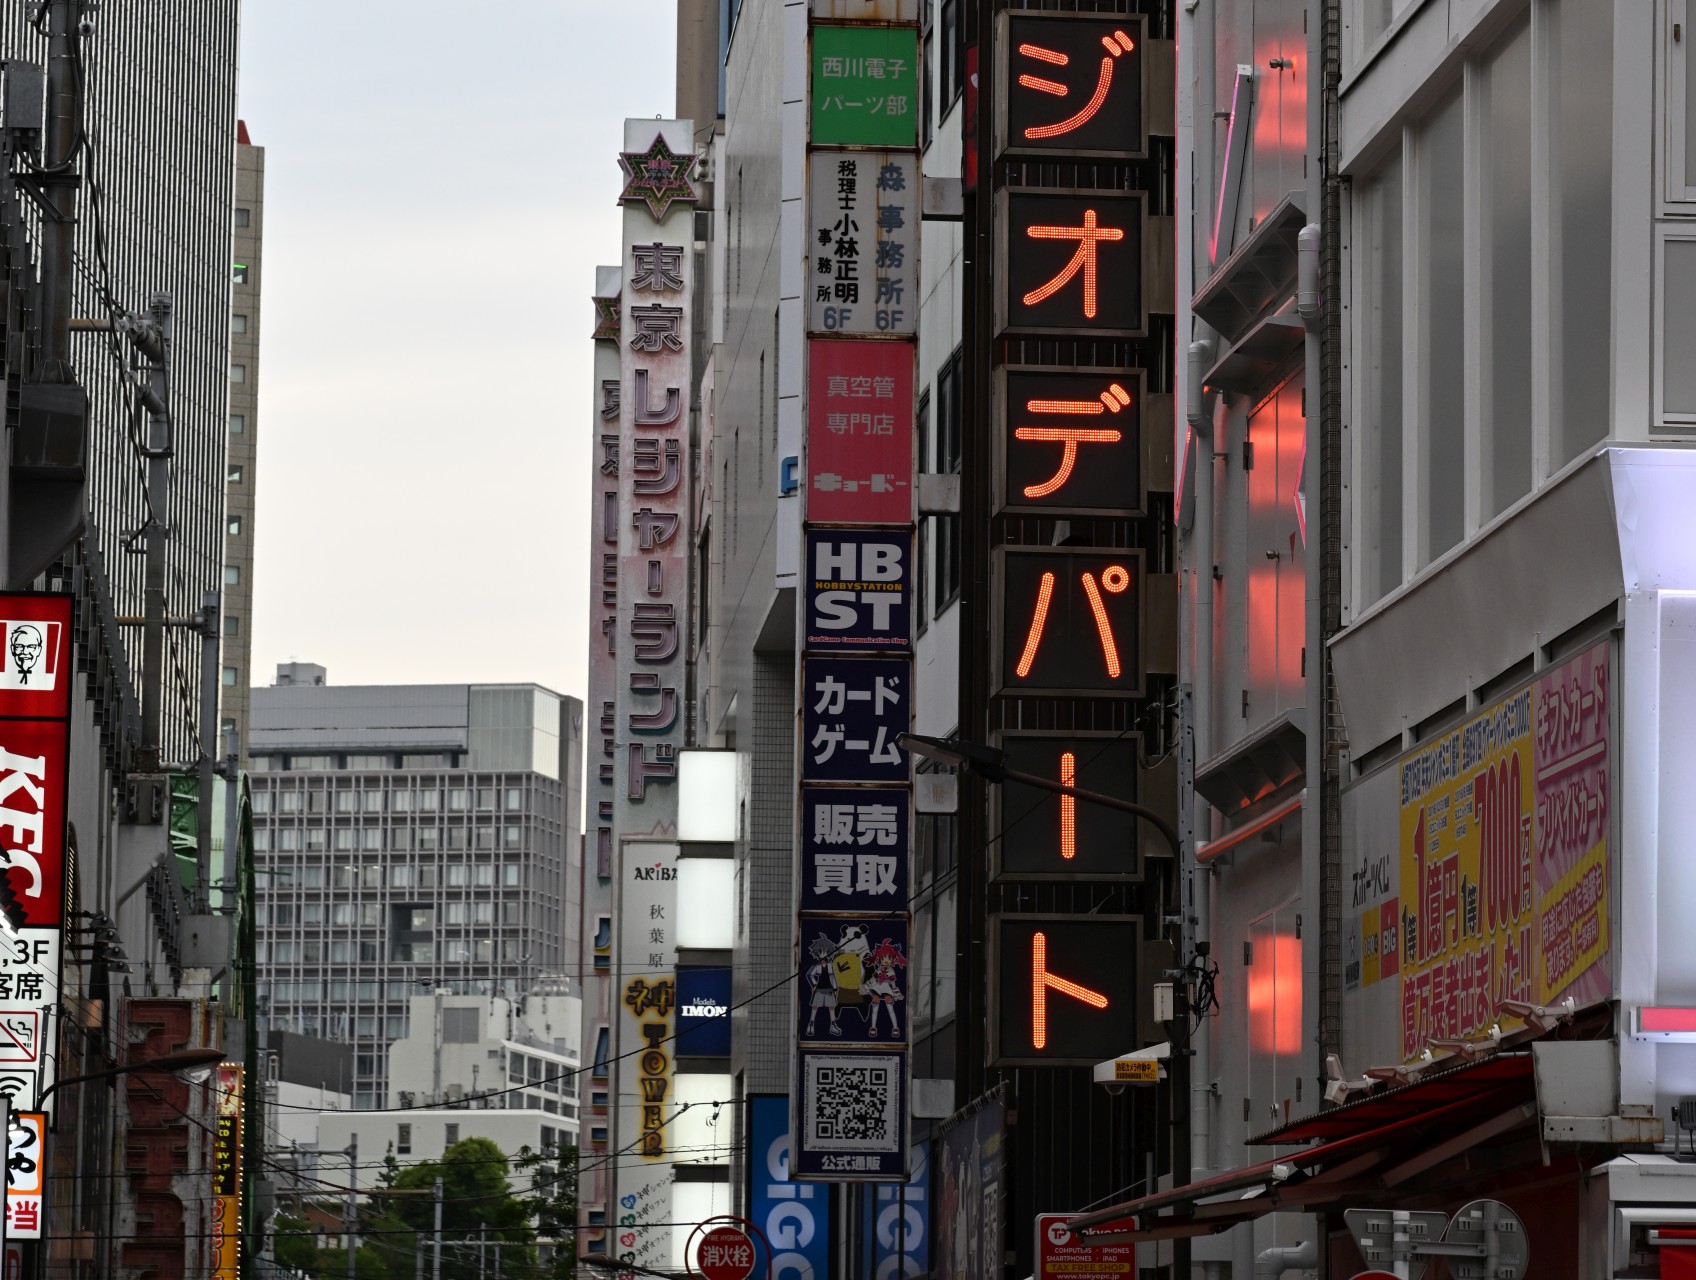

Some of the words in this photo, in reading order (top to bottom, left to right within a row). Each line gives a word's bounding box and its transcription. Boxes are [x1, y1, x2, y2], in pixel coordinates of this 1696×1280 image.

[822, 57, 908, 80] 西川電子
[821, 95, 908, 117] パーツ部
[875, 162, 906, 306] 森事務所
[816, 228, 833, 303] 事務所
[823, 306, 852, 331] 6F
[875, 310, 904, 331] 6F
[827, 375, 895, 399] 真空管
[827, 413, 895, 436] 専門店
[815, 542, 903, 582] HB
[815, 581, 903, 590] HOBBYSTATION
[814, 590, 902, 631] ST
[813, 675, 900, 716] カード
[1537, 665, 1606, 753] ギフトカード
[811, 723, 902, 766] ゲーム
[0, 745, 46, 899] KFC
[813, 804, 898, 846] 販売
[1537, 770, 1607, 859] プリペイドカード
[813, 853, 898, 895] 買取
[1352, 854, 1390, 909] スポーツくじ
[648, 904, 665, 968] 秋葉原
[1382, 925, 1397, 957] BIG
[681, 1005, 728, 1018] IMON
[693, 996, 716, 1006] Models
[642, 1023, 668, 1158] TOWER
[821, 1155, 881, 1171] 公式通販
[6, 1200, 39, 1231] 当
[707, 1234, 719, 1242] FIRE
[720, 1234, 745, 1242] HYDRANT
[702, 1244, 751, 1268] 消火栓
[1051, 1263, 1070, 1272] TAX
[1072, 1263, 1096, 1272] FREE
[1098, 1263, 1125, 1272] SHOP
